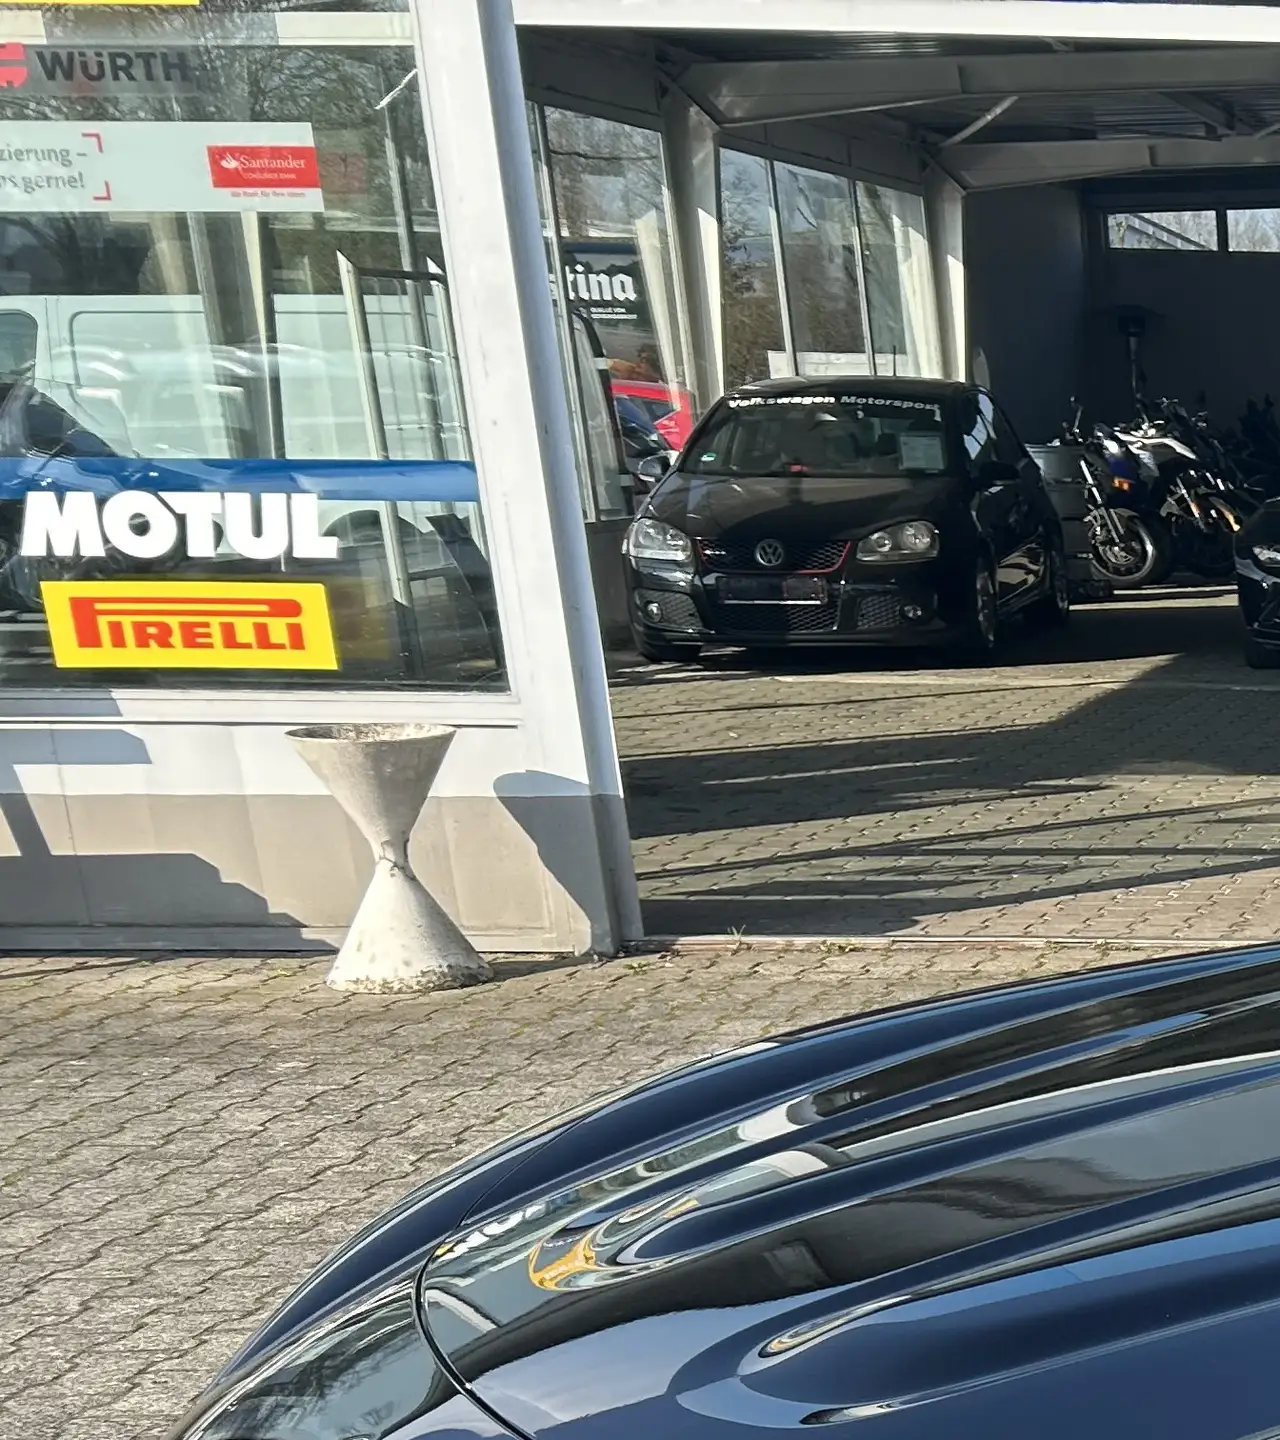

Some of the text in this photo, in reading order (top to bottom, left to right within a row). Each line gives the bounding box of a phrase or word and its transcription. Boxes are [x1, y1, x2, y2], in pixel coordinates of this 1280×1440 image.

[35, 50, 191, 82] WÜRTH
[240, 154, 306, 169] Santander
[22, 171, 85, 194] gerne!
[728, 395, 941, 411] Volkswagen Motorsport
[20, 489, 338, 560] MOTUL
[68, 596, 306, 651] PIRELLI
